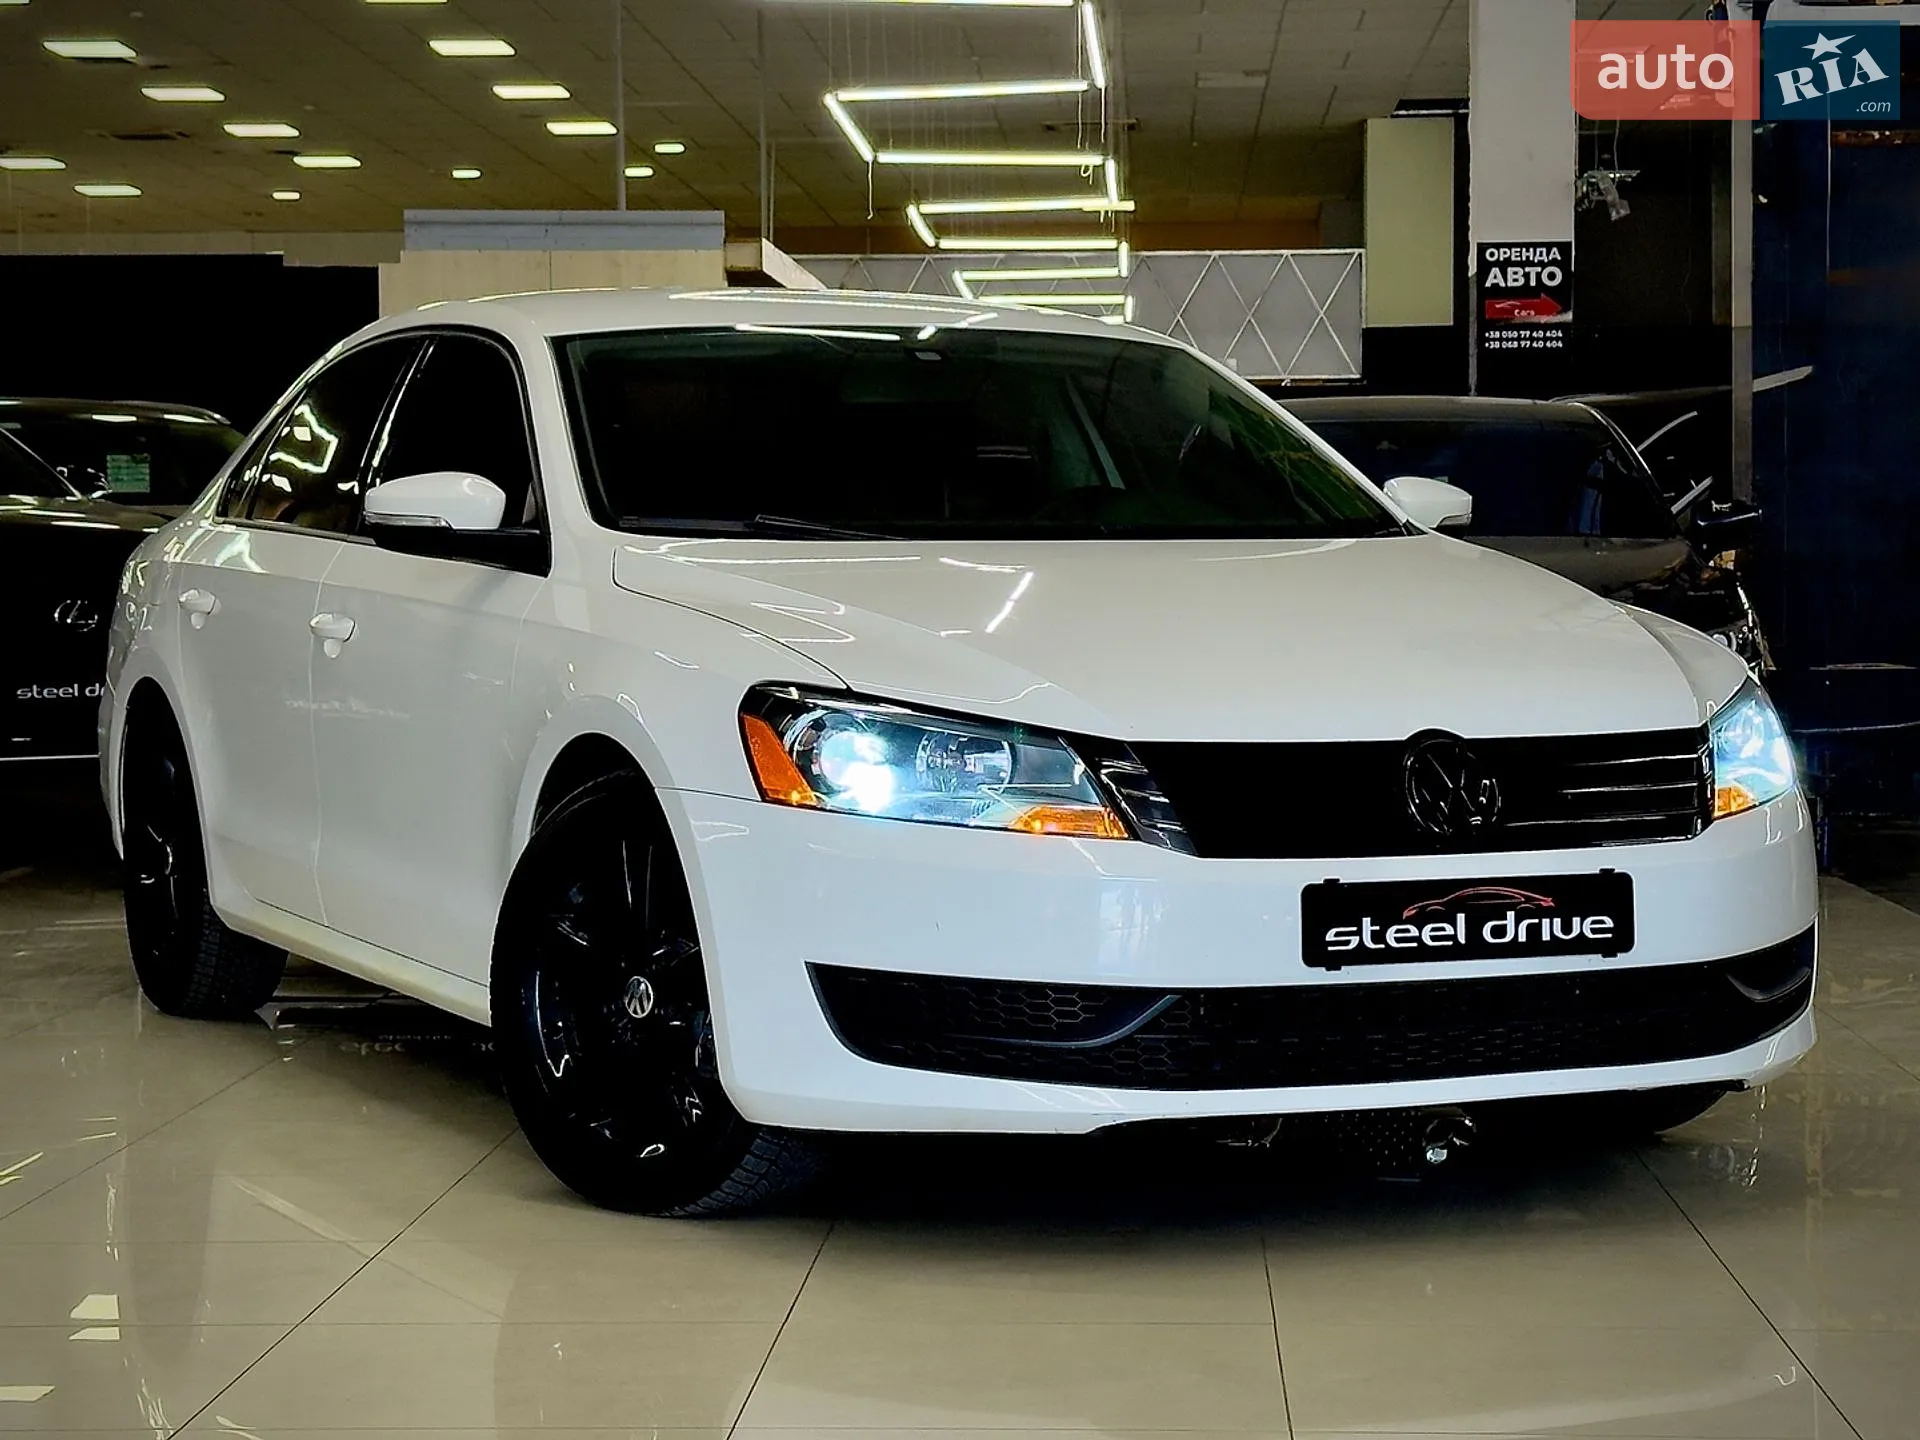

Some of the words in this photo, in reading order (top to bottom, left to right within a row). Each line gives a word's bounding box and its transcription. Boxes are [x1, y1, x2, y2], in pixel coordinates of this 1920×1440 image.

[1485, 247, 1561, 263] ОРЕНДА
[1485, 266, 1562, 287] АВТО
[16, 683, 79, 699] steel
[1325, 913, 1466, 951] steel
[1482, 910, 1614, 943] drive
